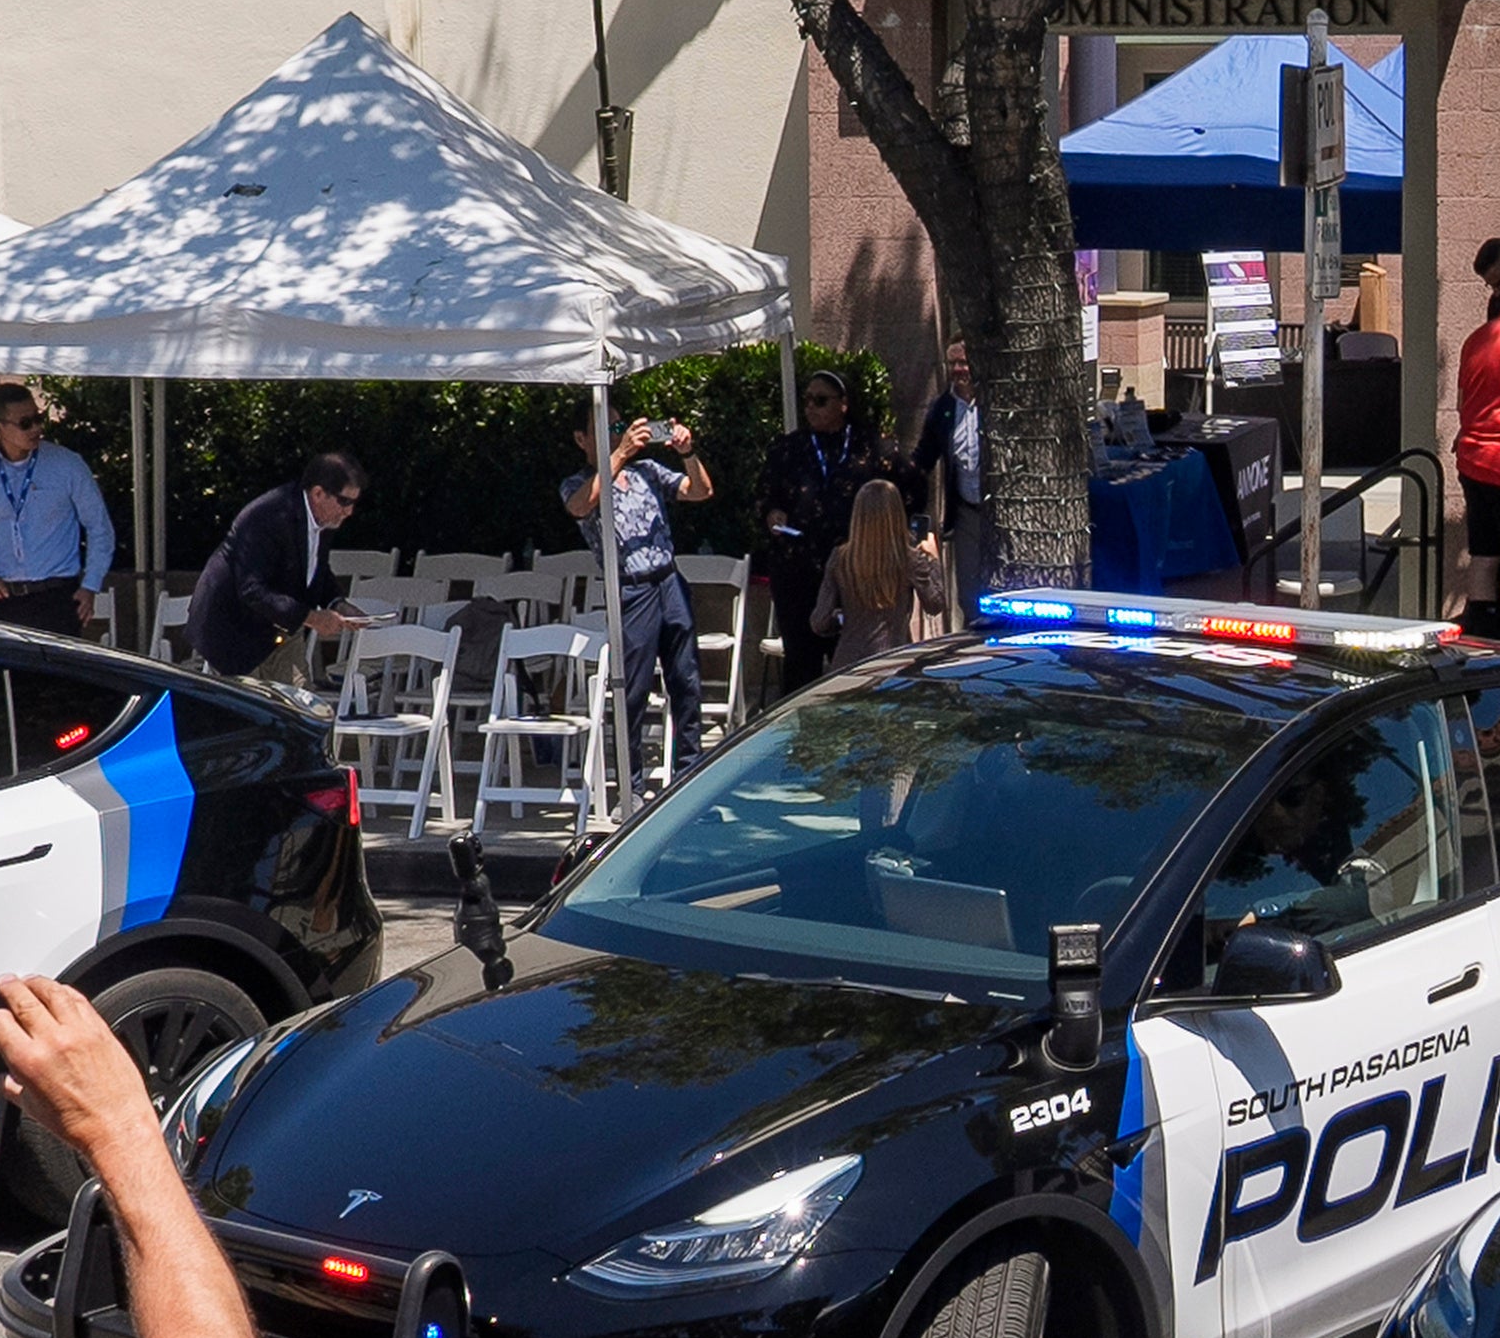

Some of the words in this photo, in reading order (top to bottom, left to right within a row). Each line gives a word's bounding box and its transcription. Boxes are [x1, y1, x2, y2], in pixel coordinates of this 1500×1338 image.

[1010, 1087, 1092, 1134] 2304
[1227, 1072, 1326, 1127] SOUTH
[1330, 1024, 1472, 1096] PASADENA
